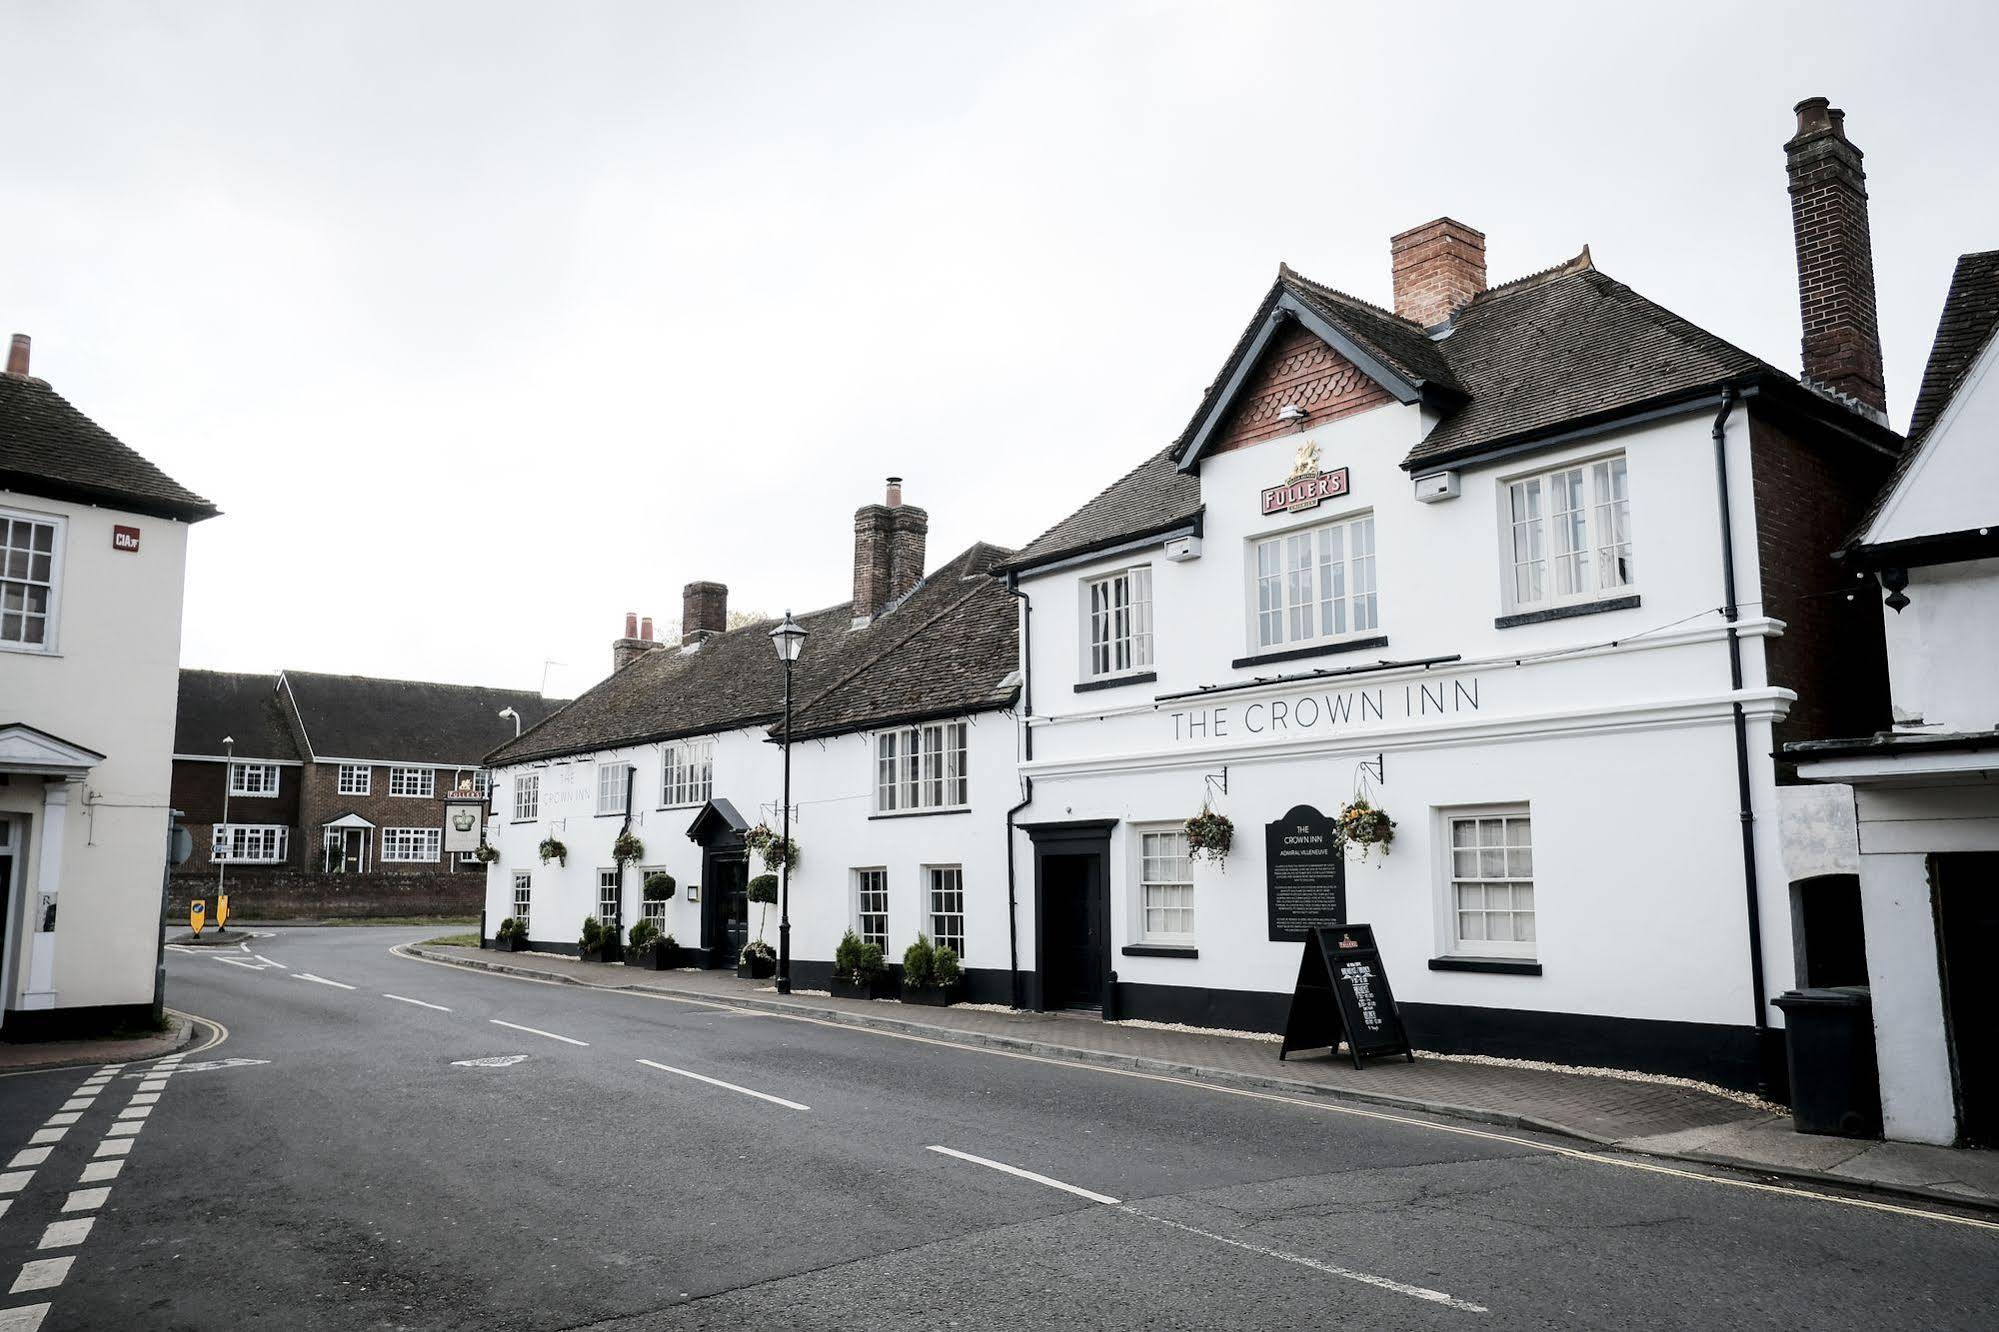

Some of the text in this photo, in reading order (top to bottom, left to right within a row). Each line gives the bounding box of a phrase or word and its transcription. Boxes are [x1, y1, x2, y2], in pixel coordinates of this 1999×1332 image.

[1265, 475, 1341, 509] FULLER'S
[1171, 677, 1480, 741] THE CROWN INN
[1283, 835, 1323, 844] CROWN INN
[1280, 848, 1328, 857] ADMIRAL VILLENEUVE
